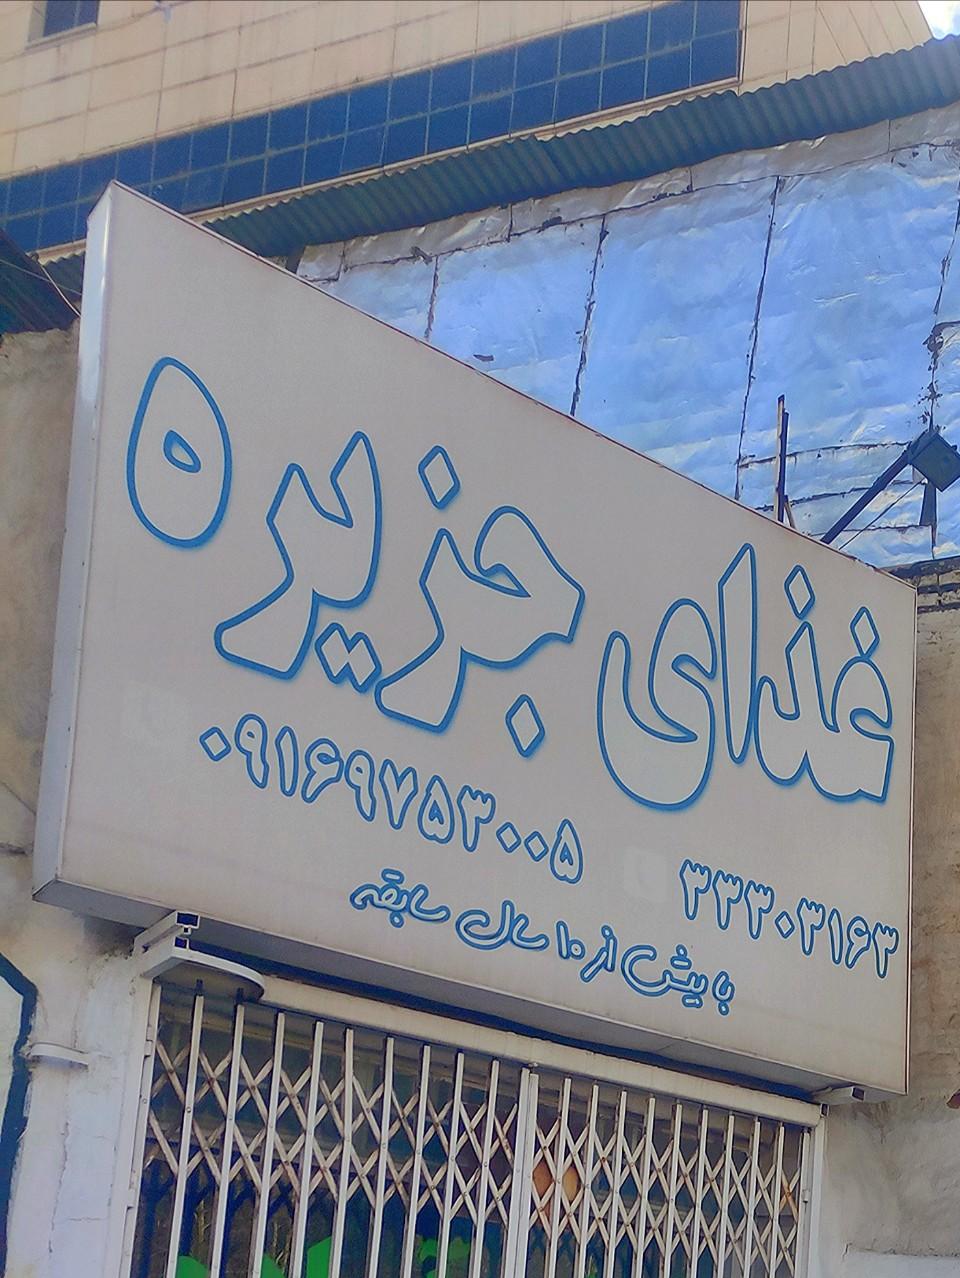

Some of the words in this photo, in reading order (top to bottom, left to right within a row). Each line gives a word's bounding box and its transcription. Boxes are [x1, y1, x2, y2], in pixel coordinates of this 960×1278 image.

[127, 356, 585, 757] جزیره
[597, 542, 893, 813] غذای
[200, 713, 583, 884] ۰۹۱۶۹۷۵۳۰۰۵
[350, 868, 451, 928] سابقه
[455, 900, 550, 951] سال
[556, 920, 584, 960] ۱۰
[580, 925, 617, 983] از
[620, 944, 707, 1009] بیش
